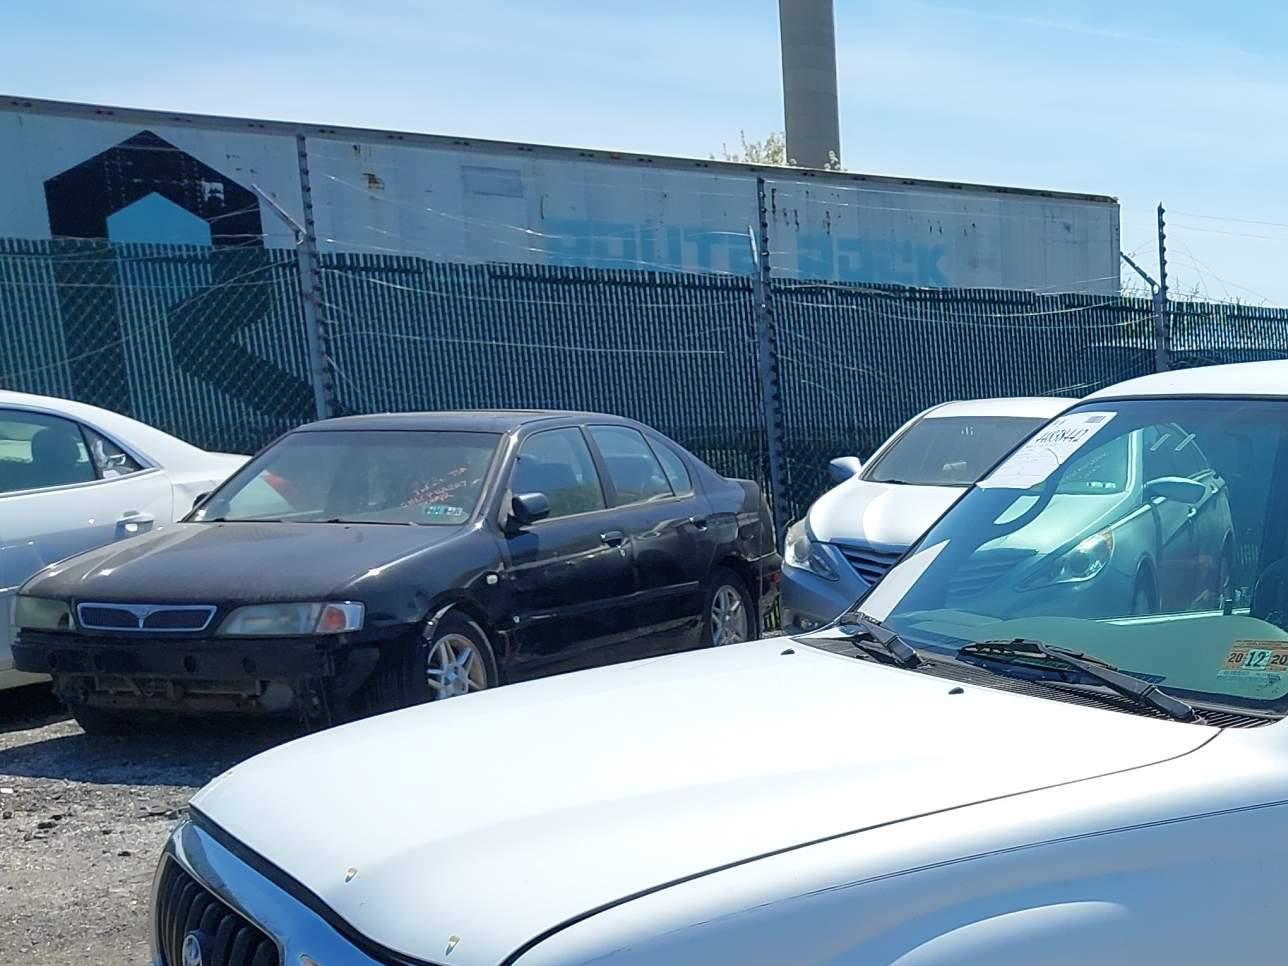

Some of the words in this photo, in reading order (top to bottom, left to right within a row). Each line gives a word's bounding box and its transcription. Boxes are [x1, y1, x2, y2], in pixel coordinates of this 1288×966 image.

[1227, 652, 1244, 663] 20
[1245, 651, 1266, 668] 12
[1270, 654, 1288, 665] 20
